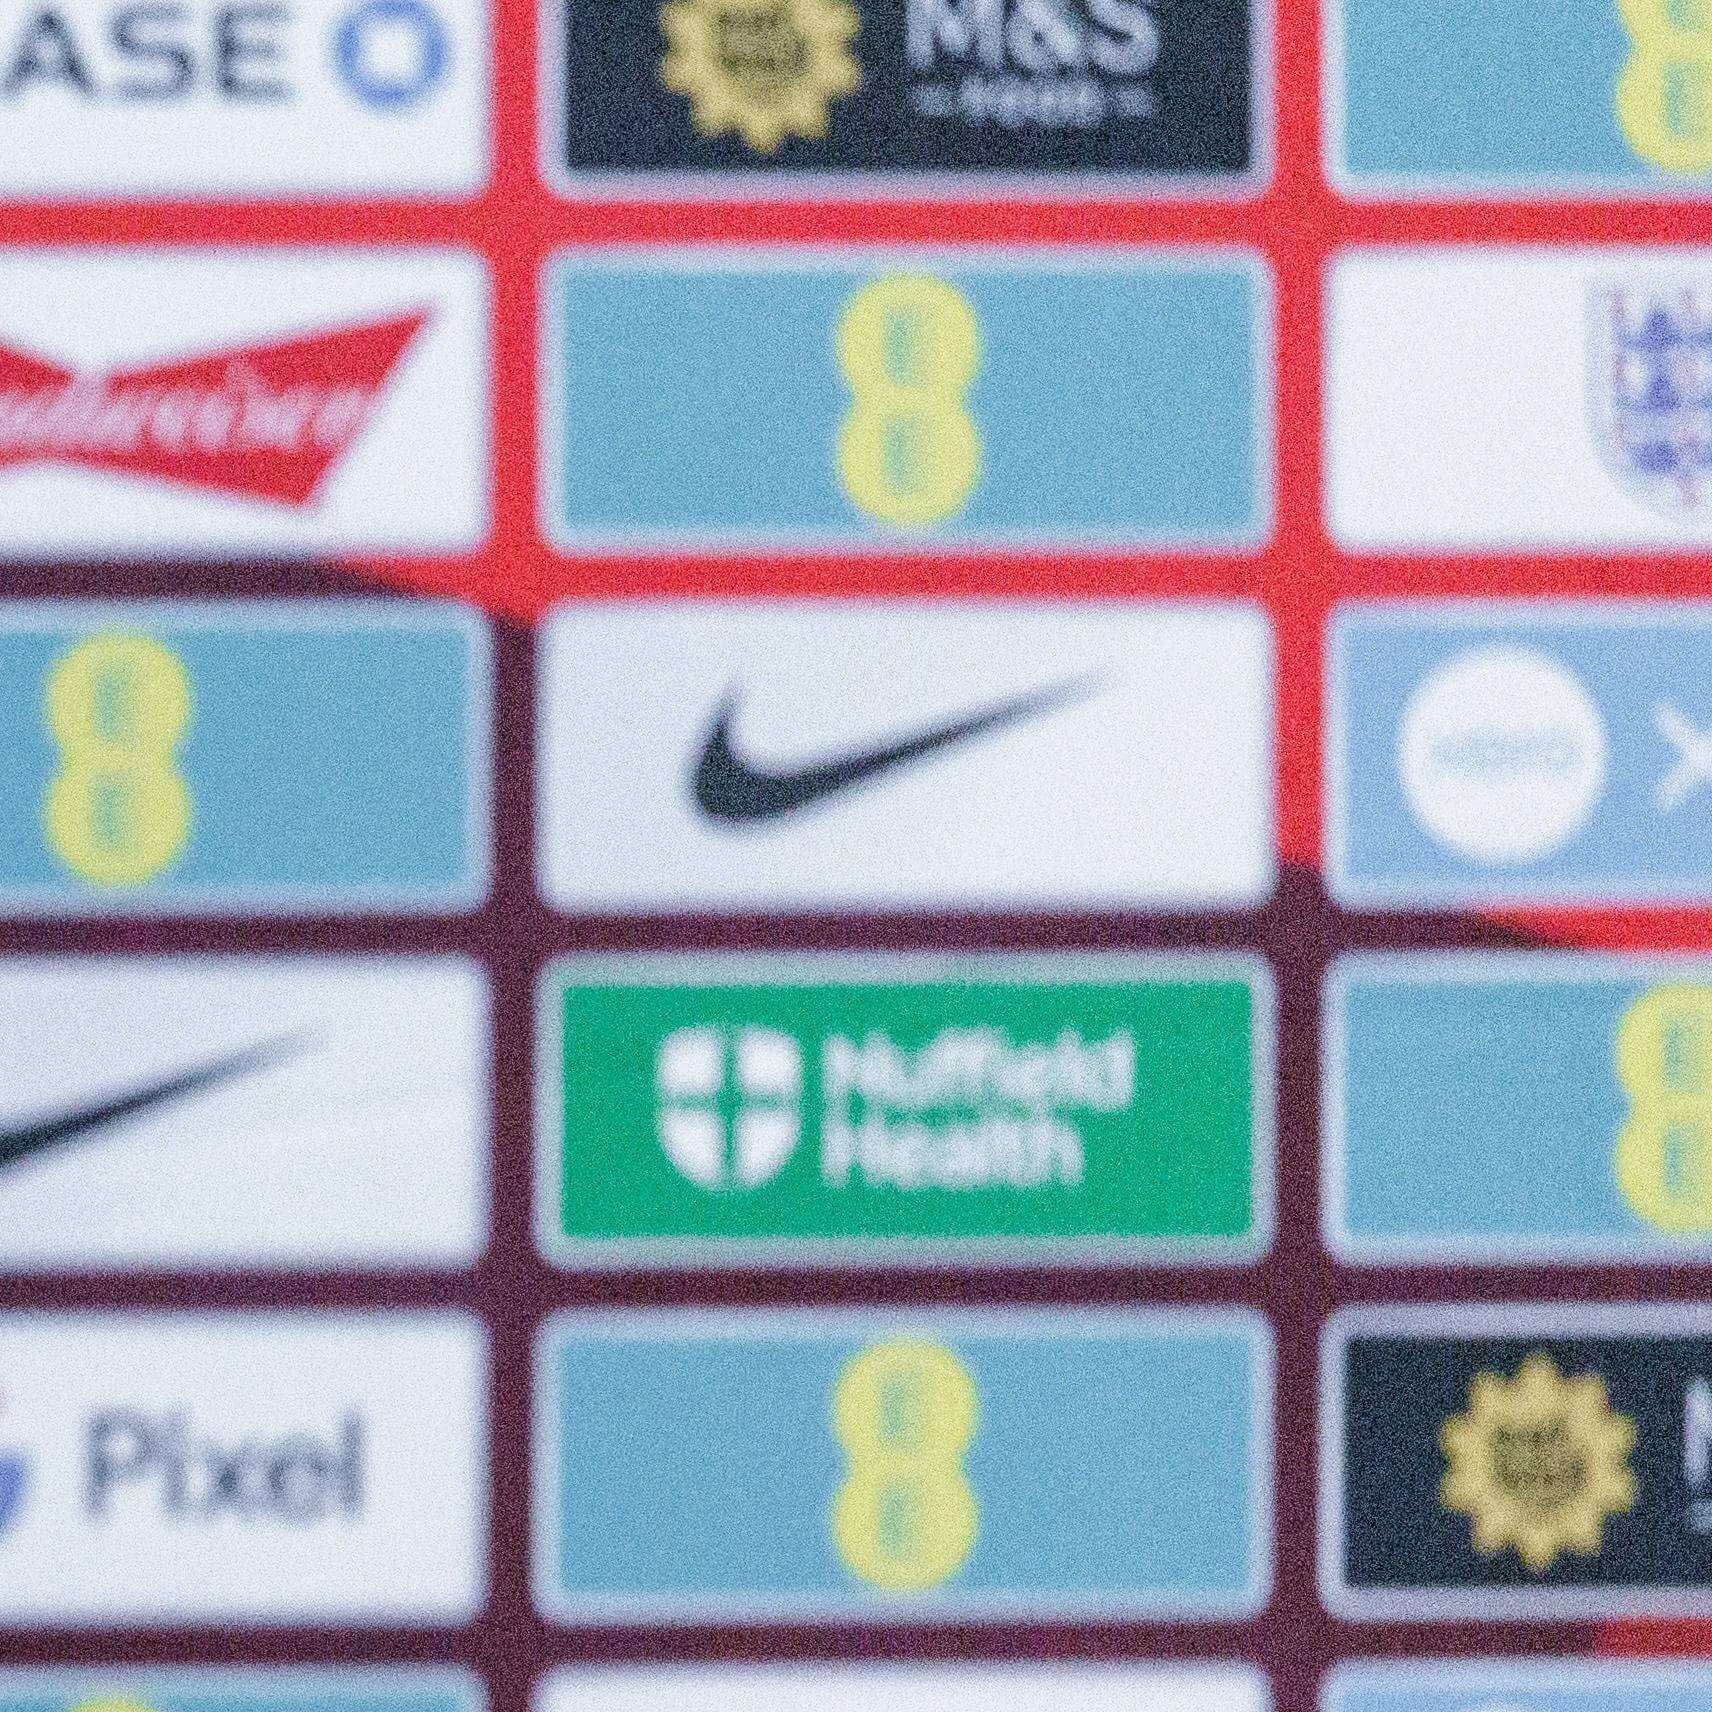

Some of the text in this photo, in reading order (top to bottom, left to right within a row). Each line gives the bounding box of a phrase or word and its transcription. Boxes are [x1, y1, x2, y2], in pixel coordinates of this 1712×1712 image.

[823, 1029, 1135, 1113] Nuffield
[822, 1110, 1084, 1189] Health
[85, 1410, 364, 1521] Pixel
